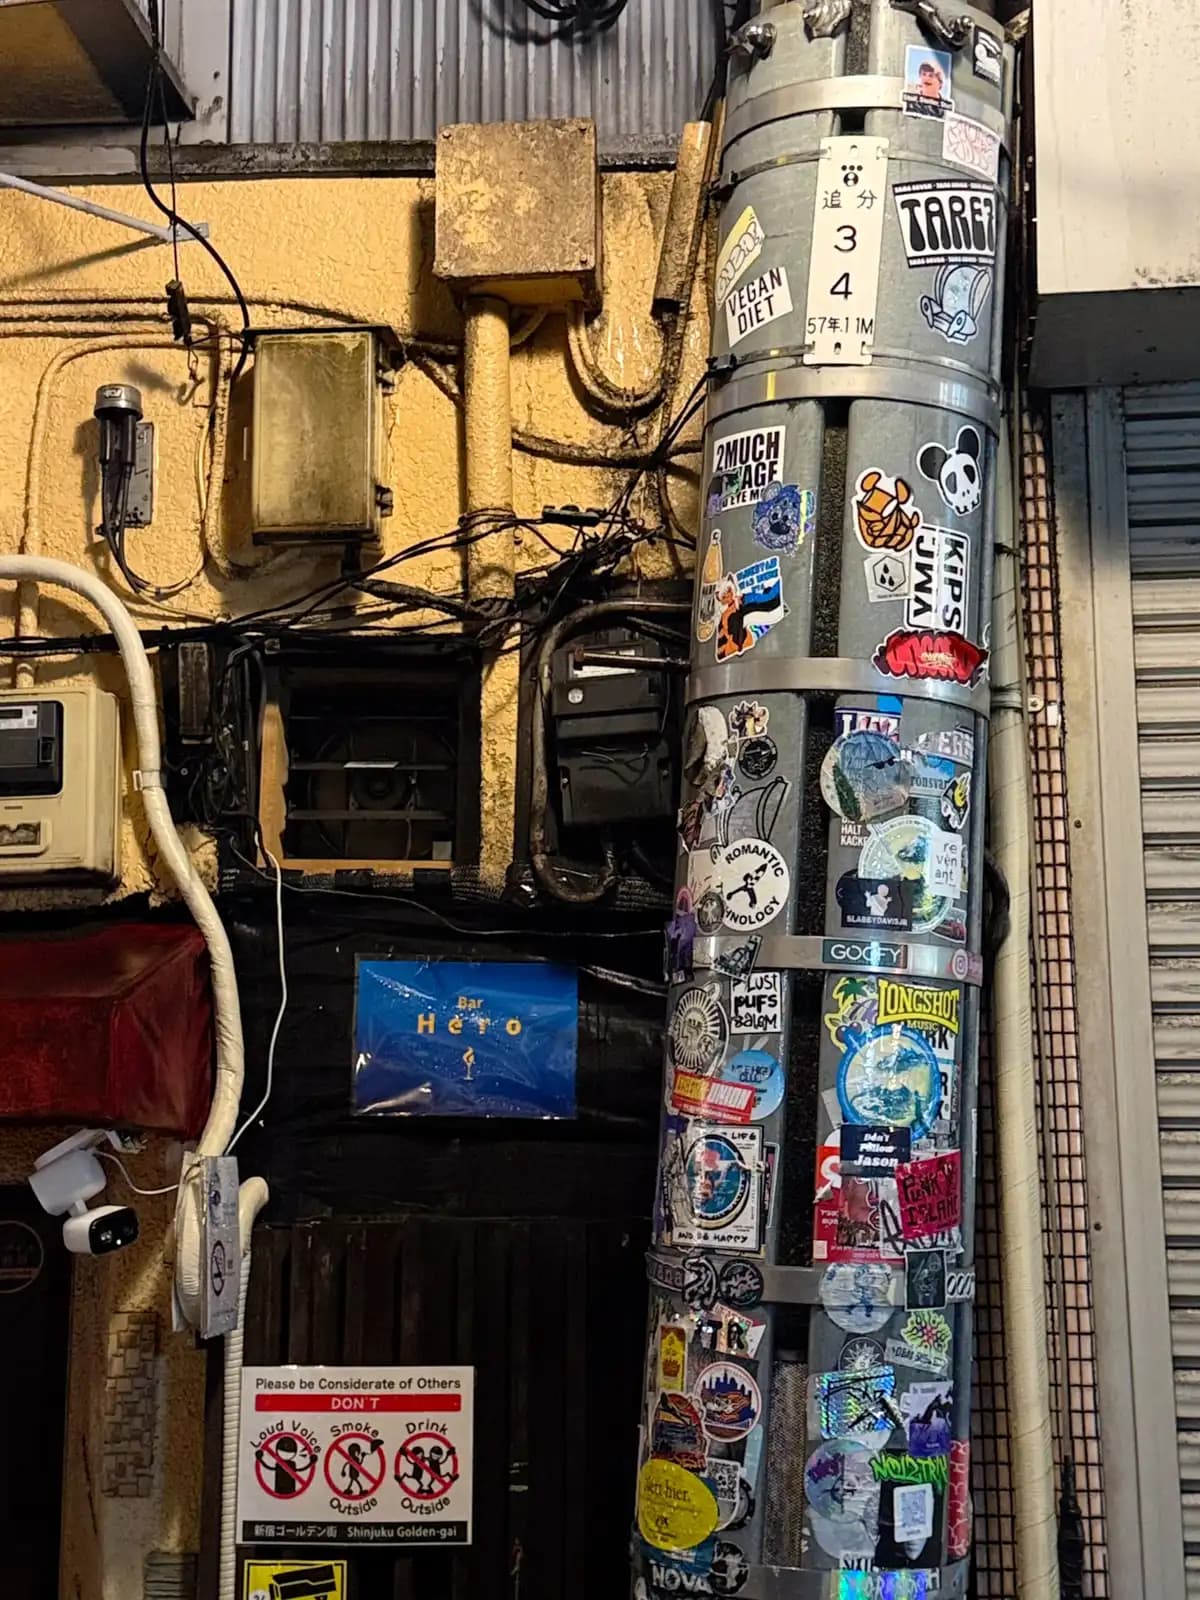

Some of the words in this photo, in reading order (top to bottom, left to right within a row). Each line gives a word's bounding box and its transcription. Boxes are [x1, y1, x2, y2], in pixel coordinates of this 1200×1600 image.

[834, 225, 857, 253] 3
[728, 267, 782, 317] VEGAN
[830, 272, 853, 300] 4
[738, 294, 774, 335] DIET
[716, 431, 780, 471] 2MUCH
[724, 844, 784, 878] ROMANTIC
[457, 996, 484, 1010] Bar
[878, 979, 960, 1024] LONGSHOT
[417, 1013, 522, 1035] Hero
[853, 1154, 899, 1167] Jason
[256, 1378, 295, 1389] Please
[299, 1378, 315, 1389] be
[318, 1378, 395, 1390] Considerate
[398, 1378, 413, 1389] of
[417, 1378, 461, 1389] Others
[250, 1420, 284, 1449] Loud
[291, 1420, 322, 1453] Voice
[330, 1421, 380, 1438] Smoke
[406, 1419, 449, 1435] Drink
[329, 1497, 378, 1515] Outside
[401, 1497, 450, 1515] Outside
[254, 1524, 338, 1538] 新宿ゴールデン街
[346, 1527, 395, 1542] Shinjuku
[396, 1526, 457, 1539] Golden-gai
